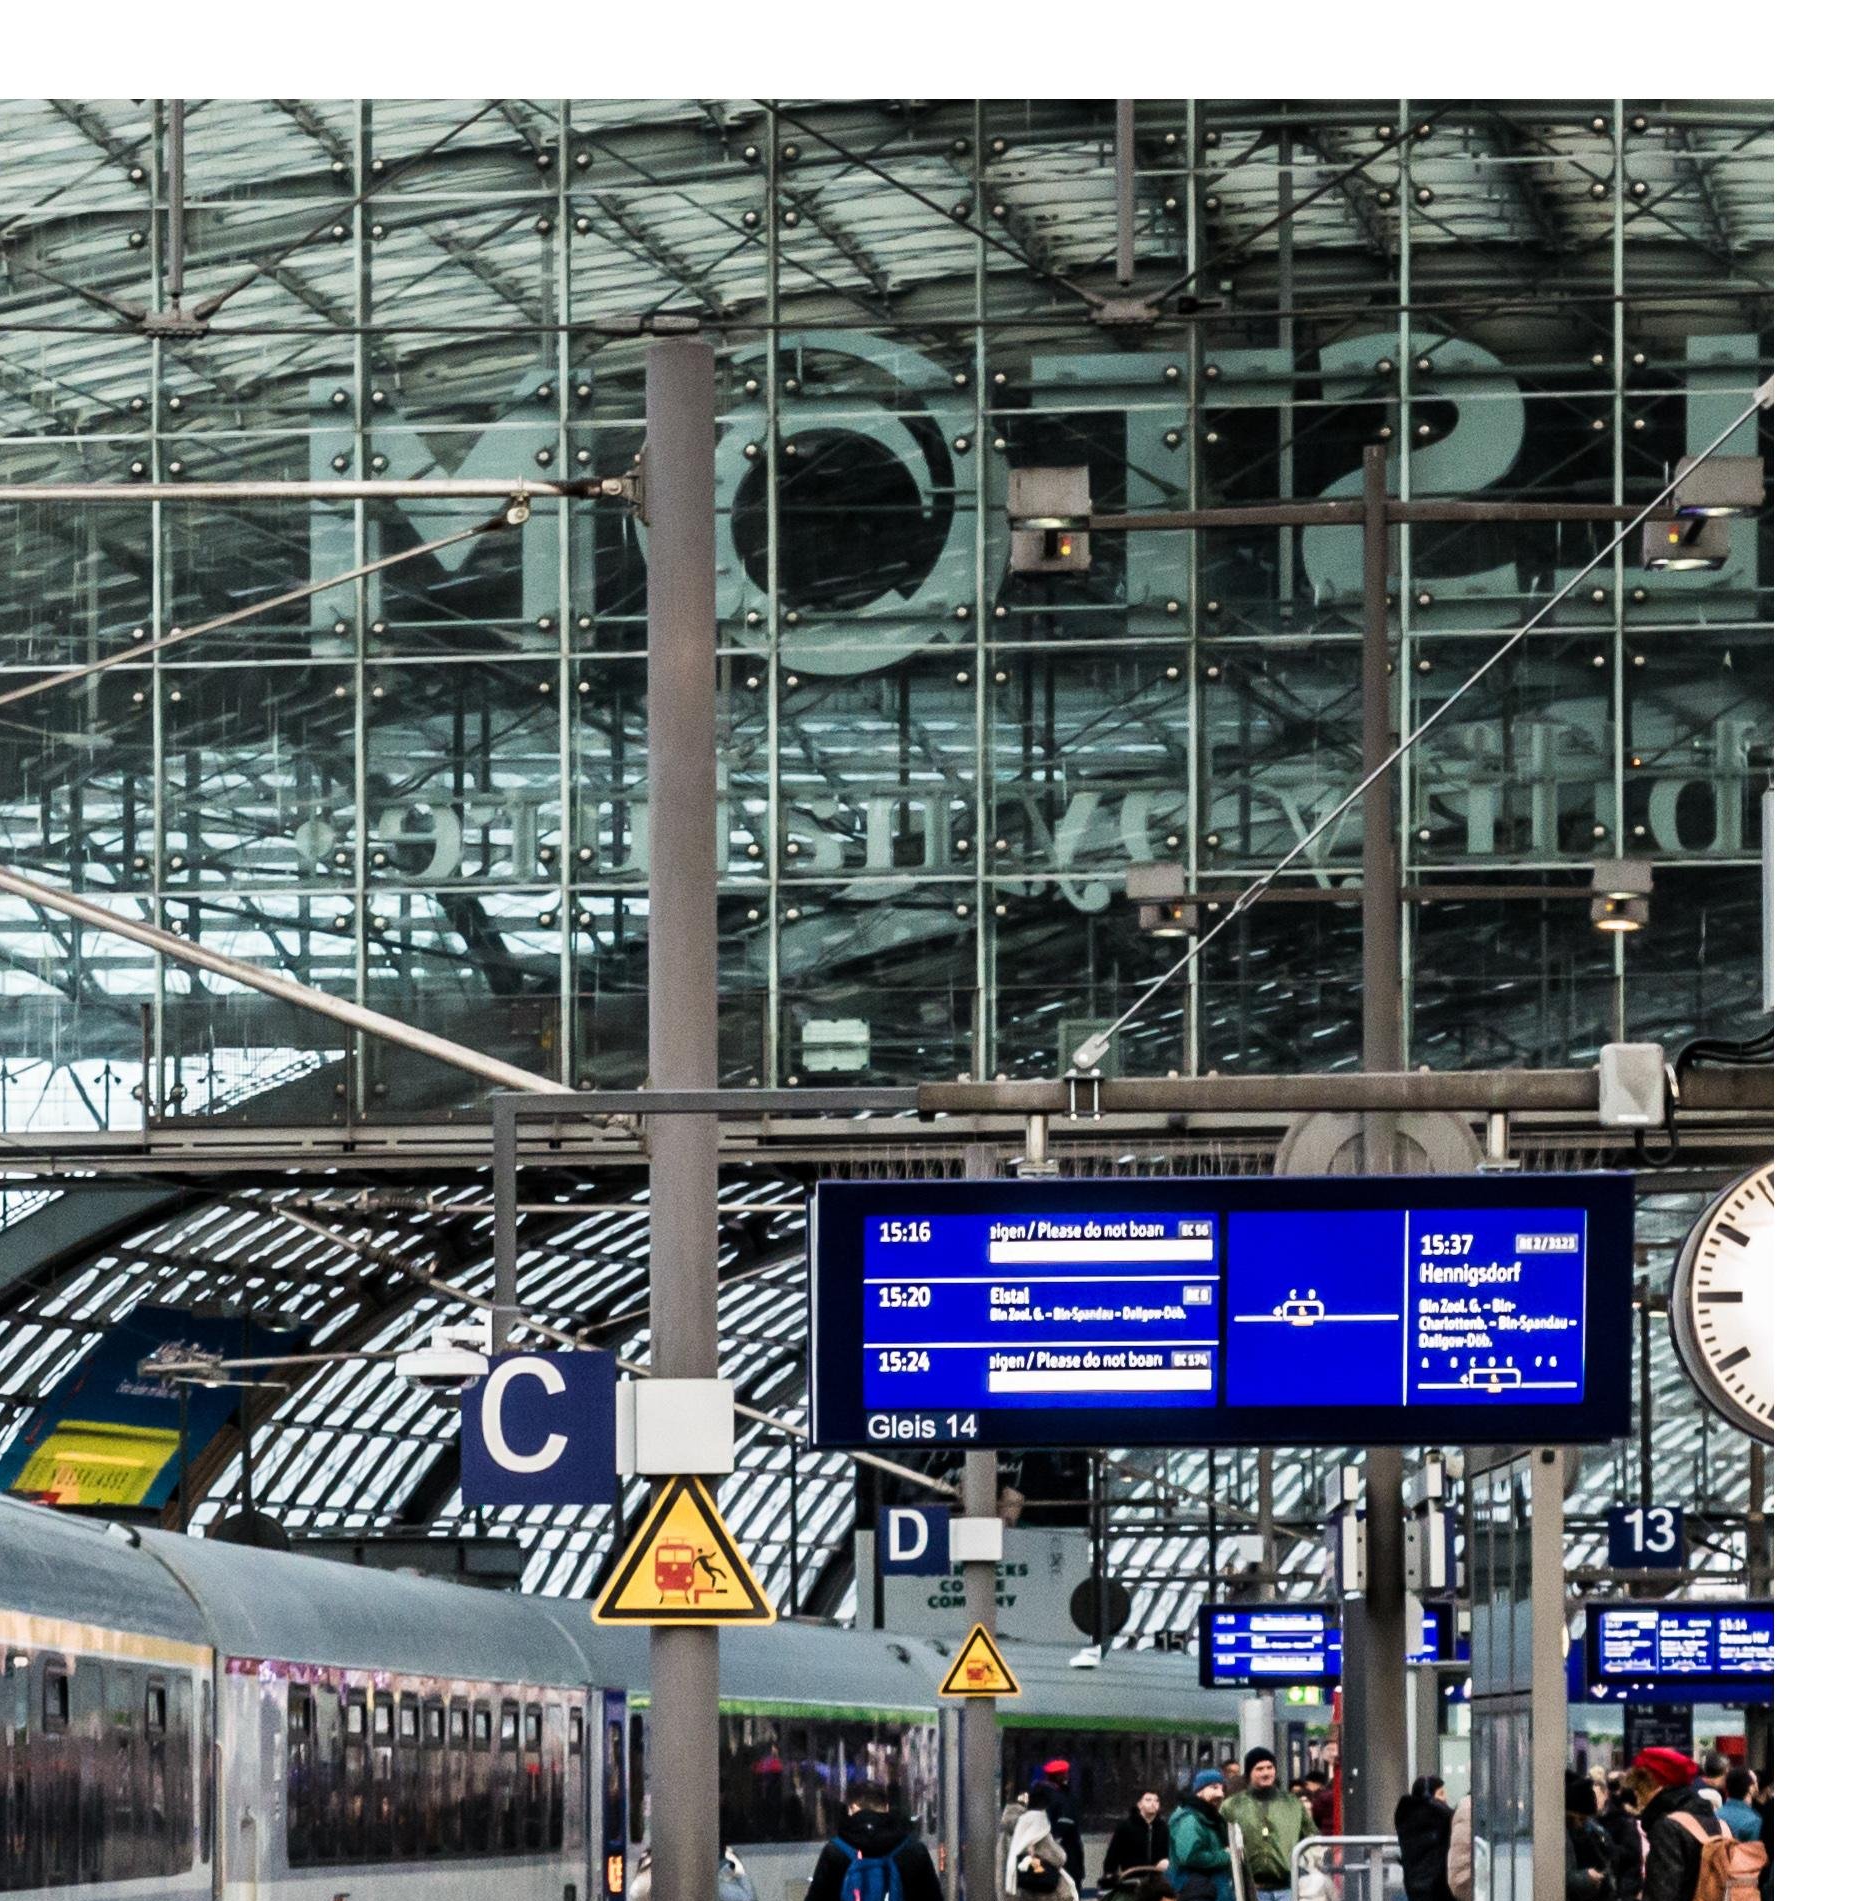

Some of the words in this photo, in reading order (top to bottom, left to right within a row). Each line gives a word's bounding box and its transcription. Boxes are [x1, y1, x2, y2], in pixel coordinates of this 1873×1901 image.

[879, 1222, 931, 1243] 15:16
[1038, 1222, 1081, 1239] Please
[1084, 1221, 1101, 1238] do
[1104, 1222, 1127, 1238] not
[1421, 1234, 1474, 1255] 15:37
[1419, 1261, 1522, 1287] Hennigsdorf
[879, 1286, 931, 1307] 15:20
[879, 1351, 930, 1372] 15:24
[1037, 1352, 1080, 1369] Please
[1083, 1351, 1101, 1368] do
[1103, 1352, 1126, 1368] not
[480, 1356, 569, 1473] C
[868, 1413, 936, 1440] Gleis
[946, 1413, 977, 1439] 14
[889, 1509, 929, 1561] D
[1624, 1508, 1675, 1552] 13
